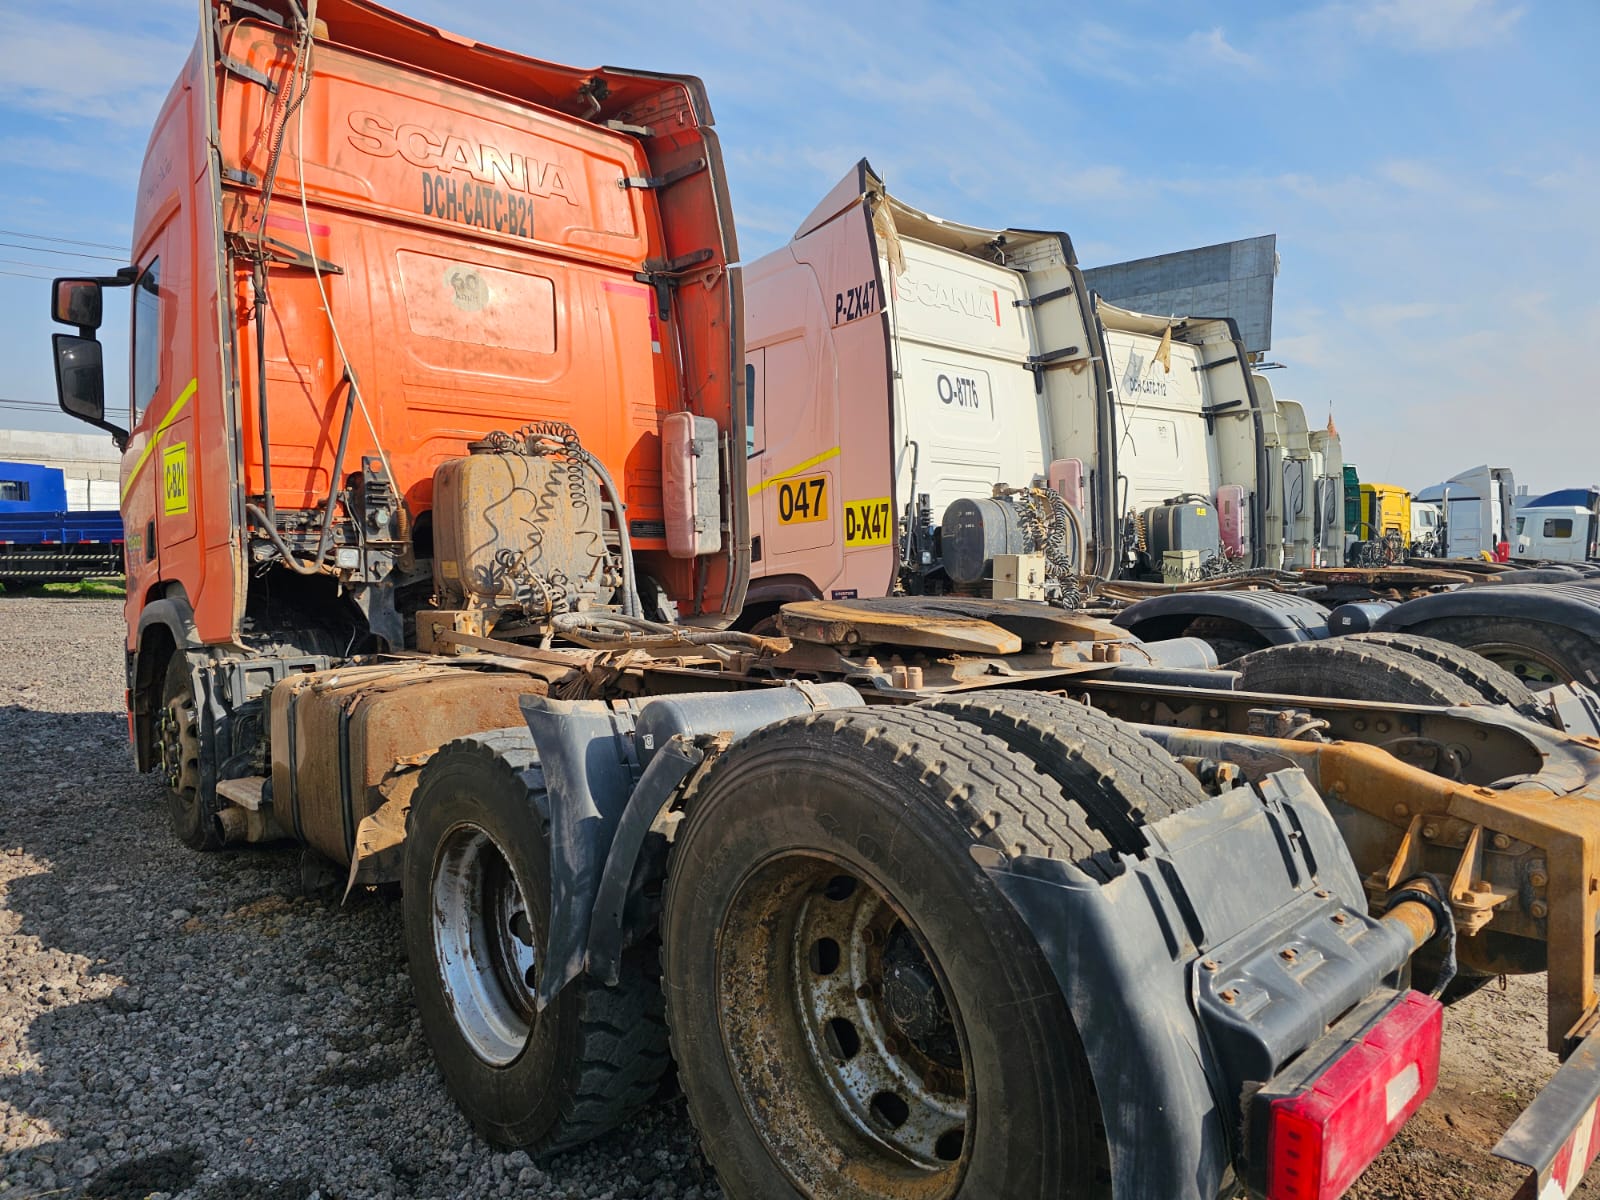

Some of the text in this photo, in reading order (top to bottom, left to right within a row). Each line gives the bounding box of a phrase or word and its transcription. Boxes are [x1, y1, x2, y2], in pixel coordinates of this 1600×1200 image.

[347, 110, 579, 207] SCANIA
[422, 171, 535, 240] DCH-CATC-B21
[835, 280, 876, 325] P-ZX47
[897, 276, 996, 323] SCANIA
[166, 461, 185, 499] C-B21
[779, 478, 825, 521] 047
[845, 503, 889, 541] D-X47
